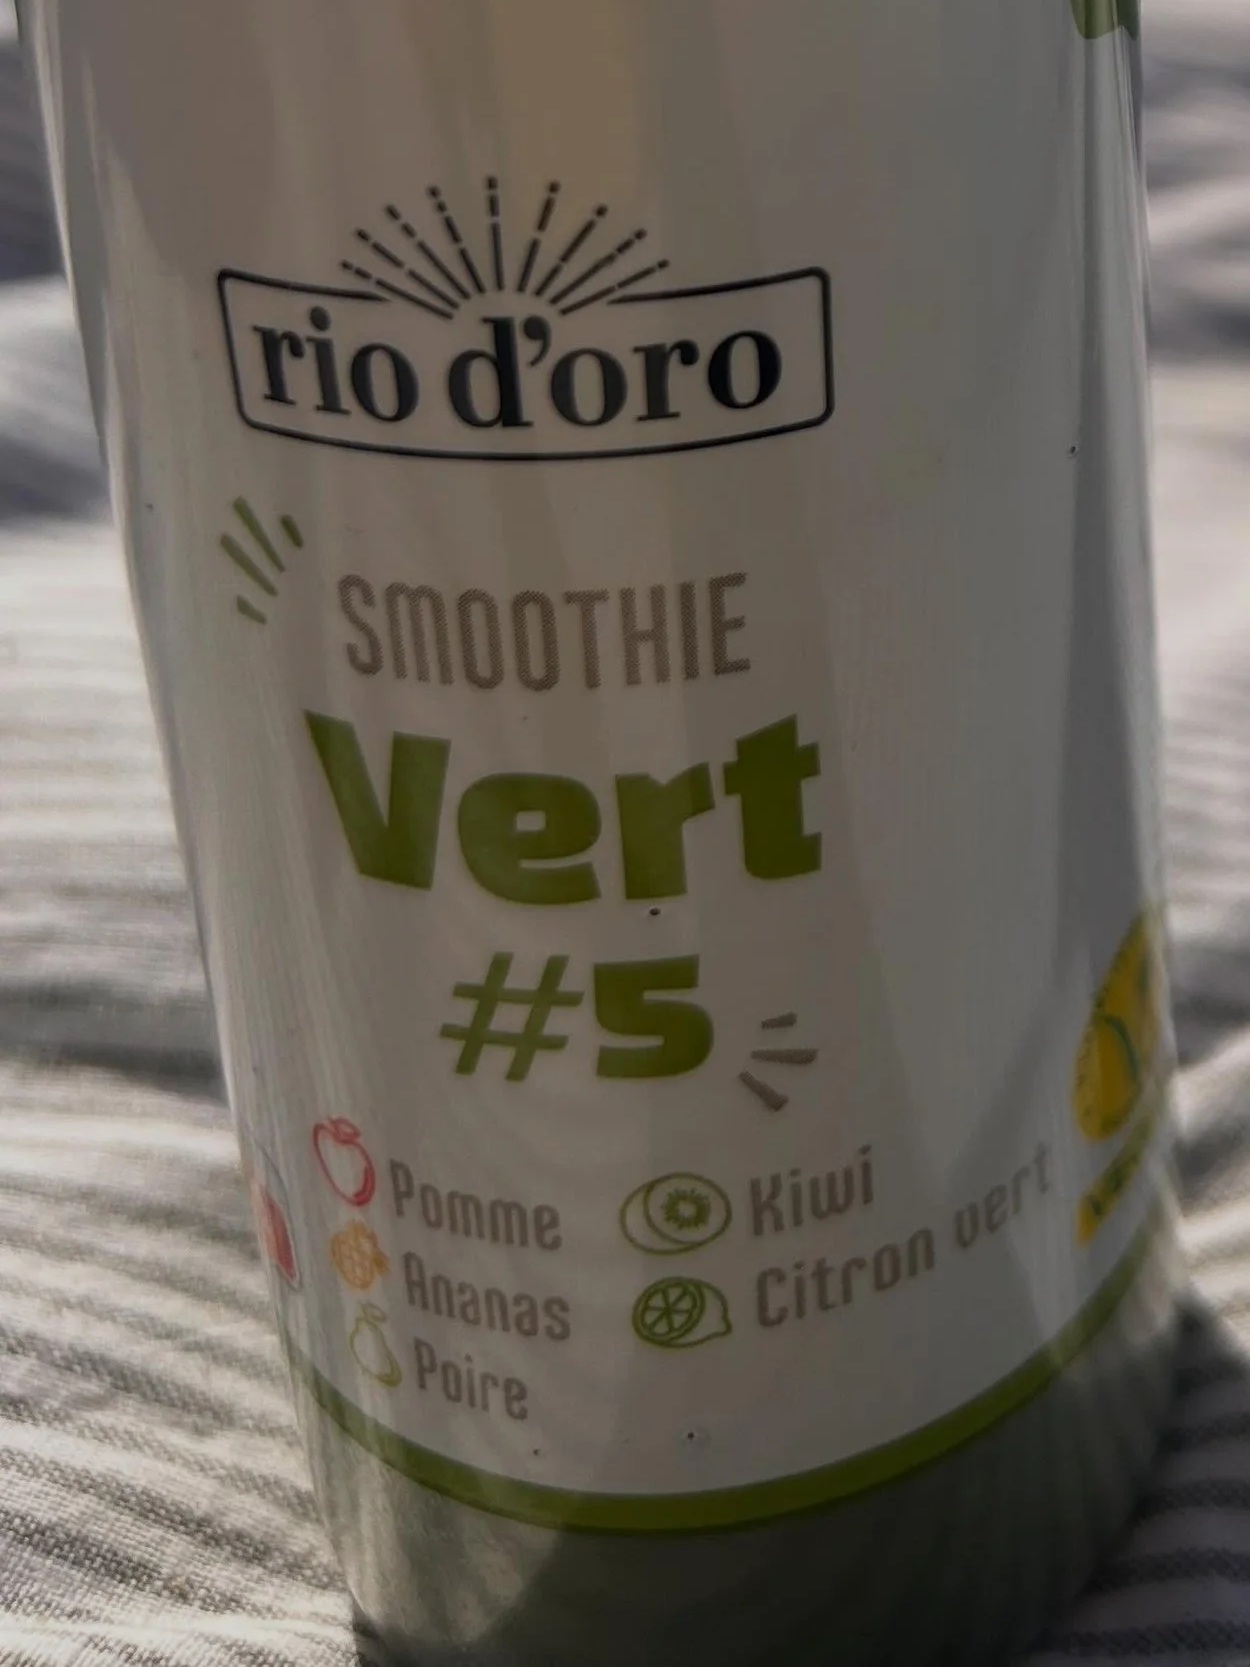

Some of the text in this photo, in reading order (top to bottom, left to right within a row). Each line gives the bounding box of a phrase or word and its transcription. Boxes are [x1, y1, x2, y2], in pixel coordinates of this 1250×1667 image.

[251, 305, 420, 423] rio
[338, 572, 752, 691] SMOOTHIE
[304, 709, 822, 905] Vert
[439, 952, 715, 1082] #5
[389, 1158, 563, 1252] Pomme
[748, 1144, 874, 1237] Kiwi
[756, 1227, 936, 1328] Citron
[953, 1142, 1050, 1250] vert
[402, 1250, 572, 1342] Ananas
[413, 1336, 529, 1421] Poire
